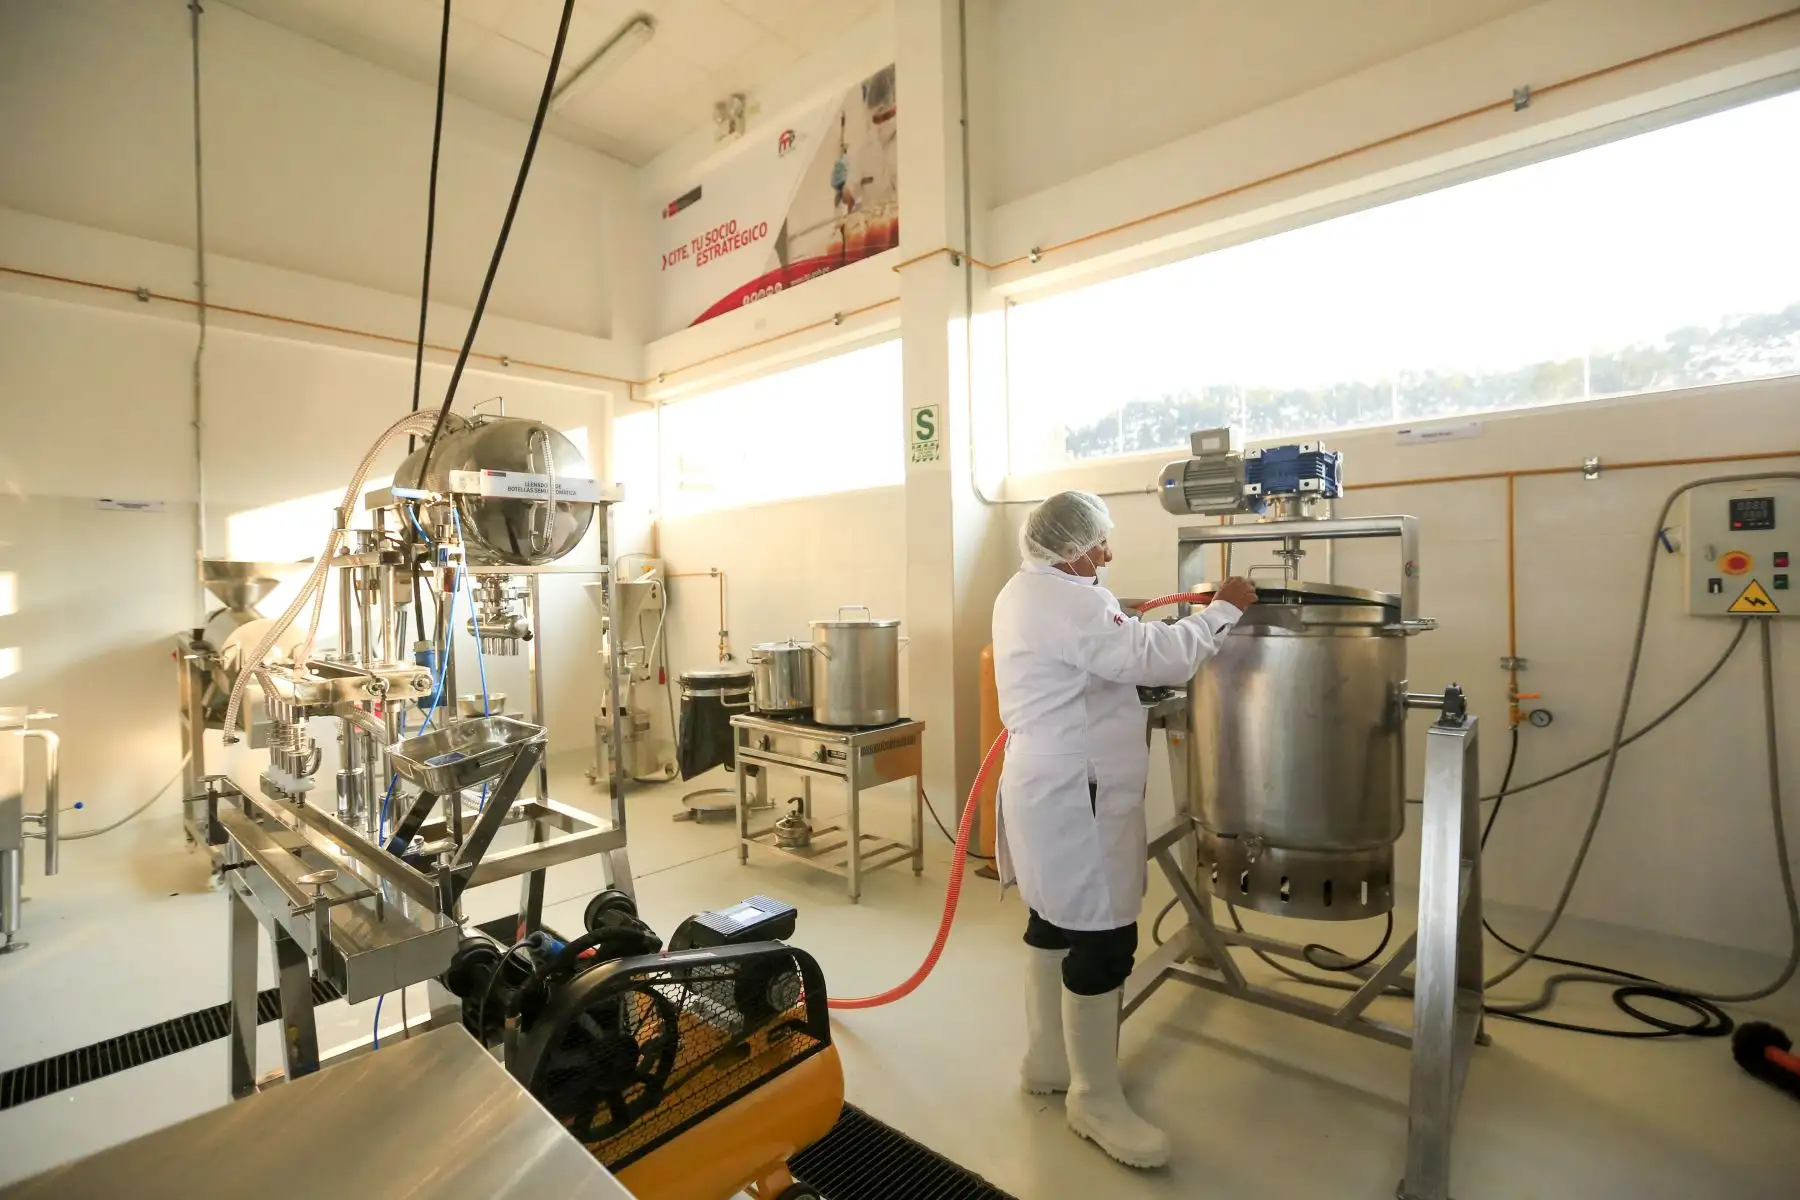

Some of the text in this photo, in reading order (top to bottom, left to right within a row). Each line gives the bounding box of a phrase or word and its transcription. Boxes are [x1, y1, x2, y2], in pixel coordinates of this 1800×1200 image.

[692, 234, 704, 254] TU
[705, 219, 737, 246] SOCIO
[916, 409, 935, 441] S
